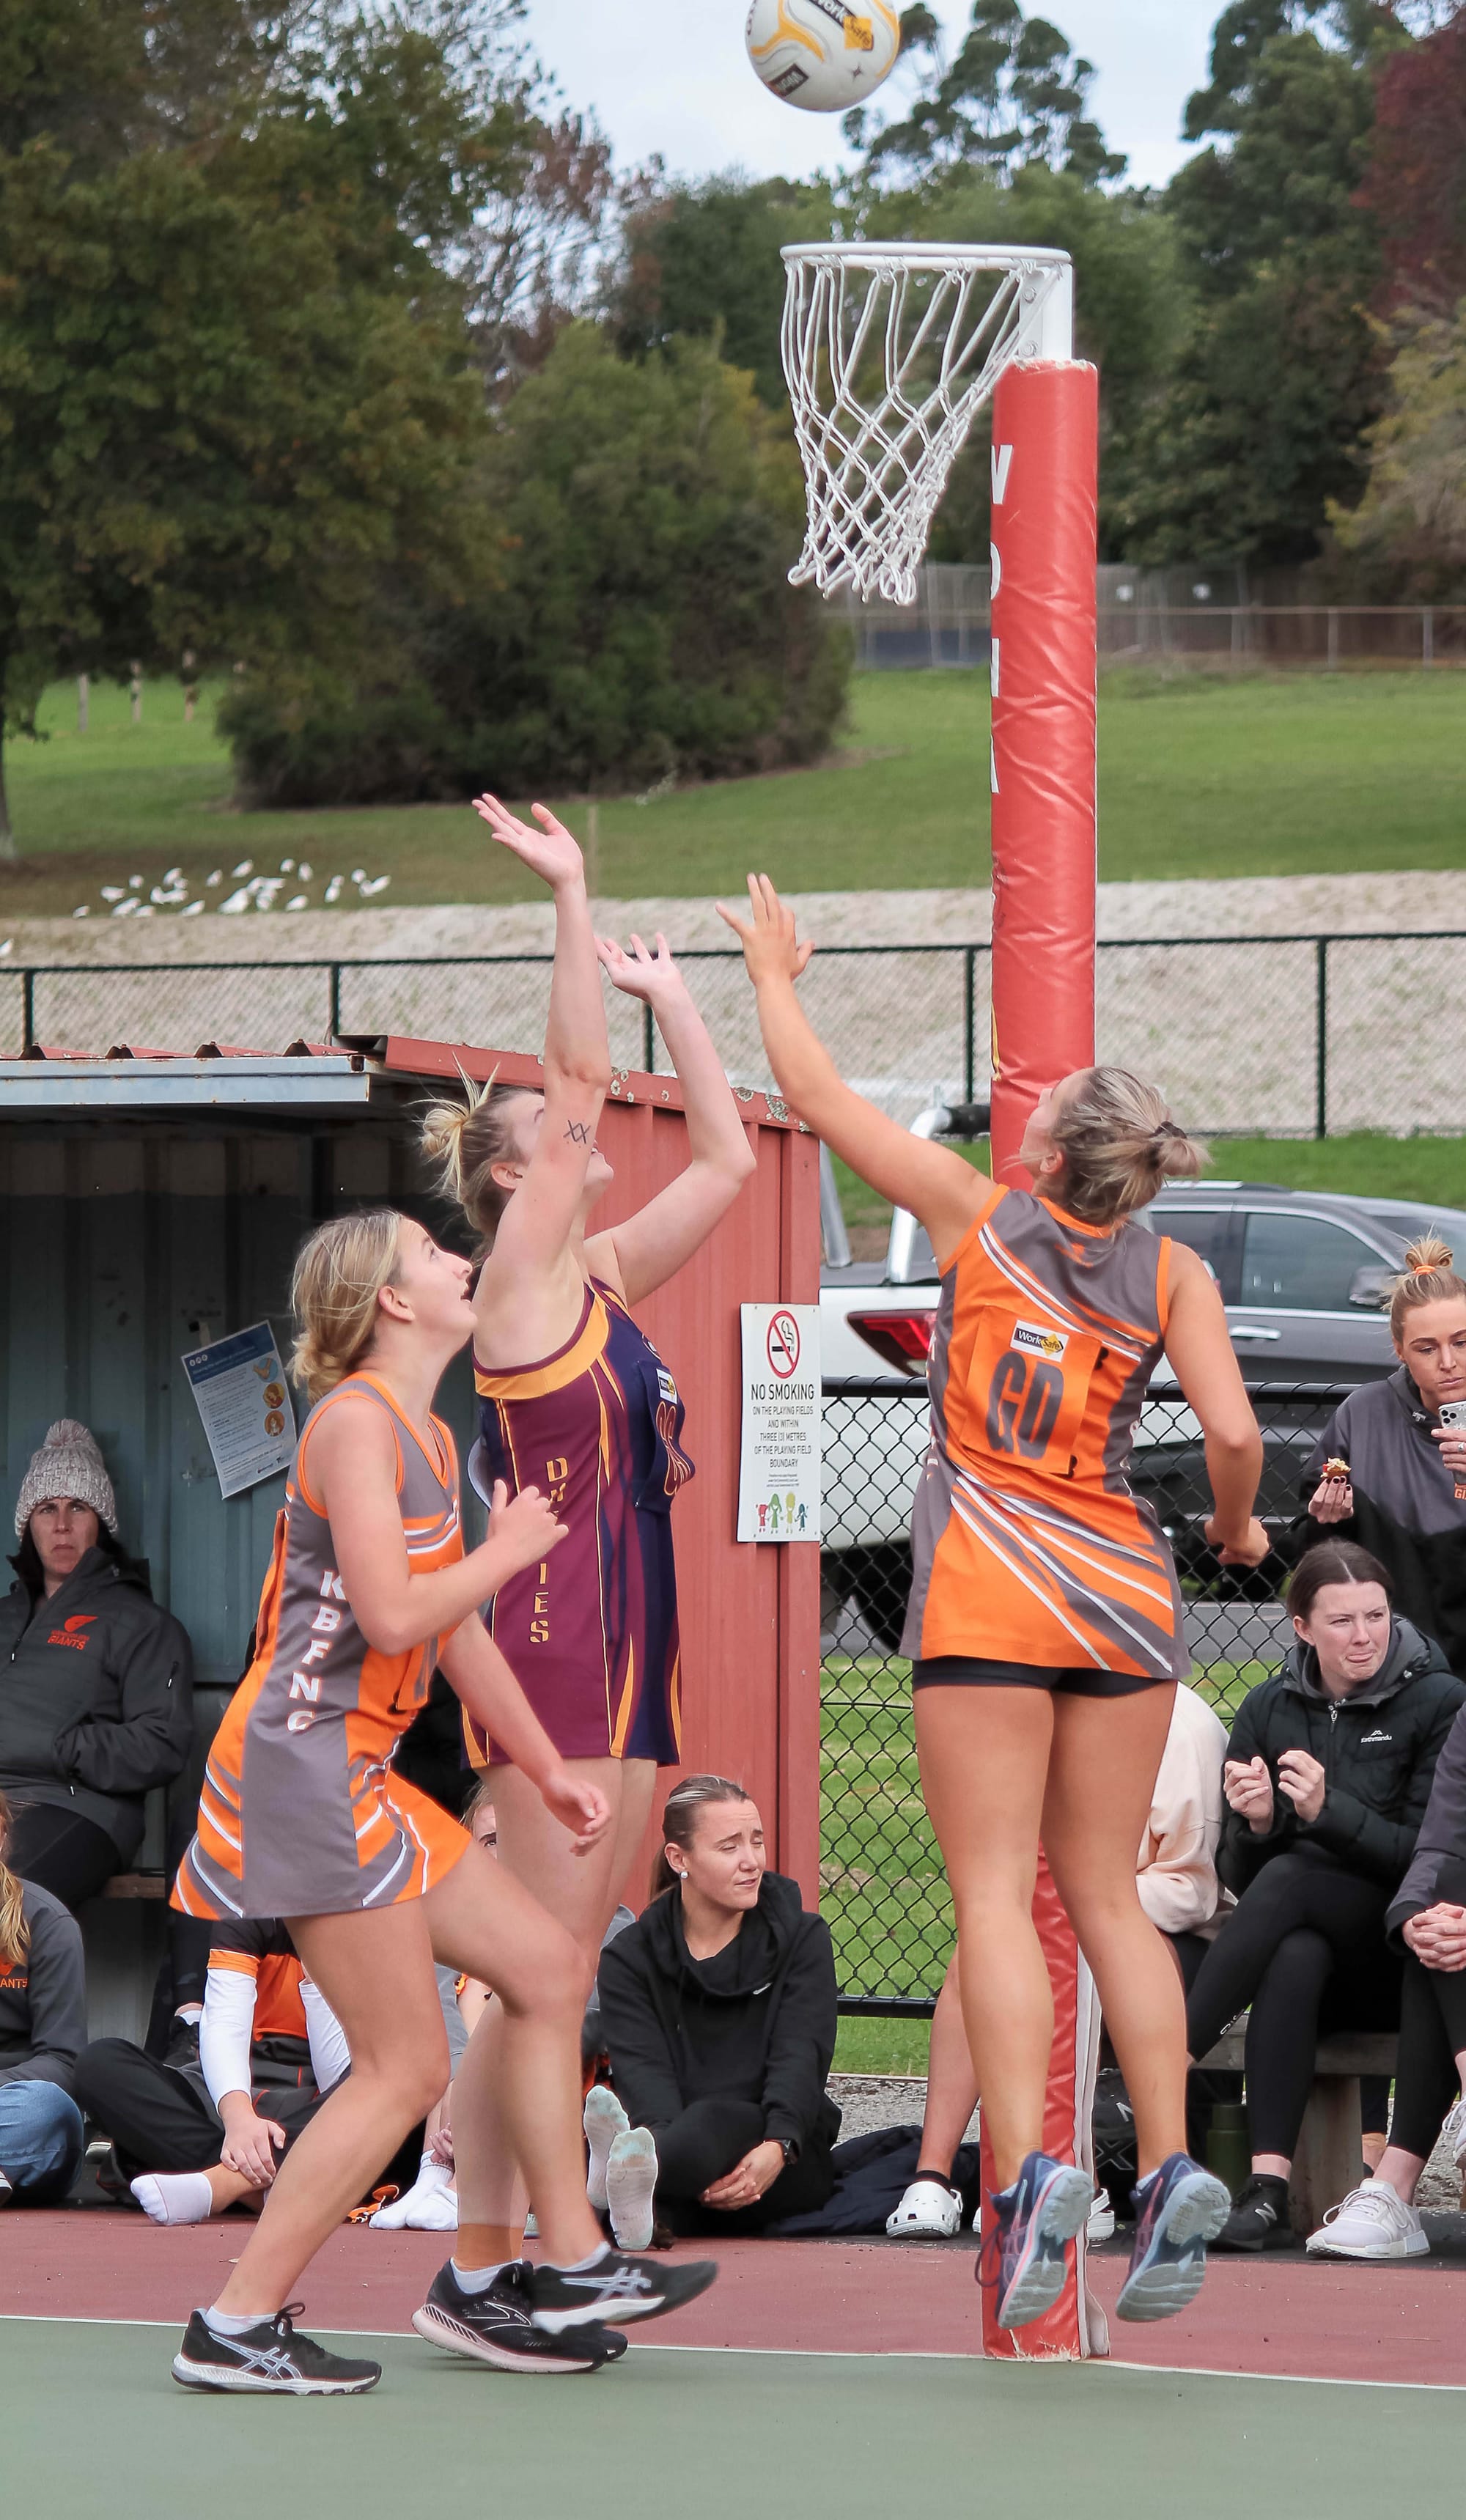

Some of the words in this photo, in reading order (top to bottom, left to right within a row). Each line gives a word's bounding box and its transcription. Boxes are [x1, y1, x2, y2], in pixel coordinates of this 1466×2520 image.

[751, 1384, 765, 1400] NO
[768, 1384, 814, 1400] SMOKING
[985, 1350, 1064, 1460] GD
[752, 1406, 760, 1415] ON
[762, 1406, 772, 1415] THE
[773, 1406, 795, 1415] PLAYING
[796, 1406, 814, 1415] FIELDS
[767, 1419, 778, 1428] AND
[780, 1419, 799, 1428] WITHIN
[760, 1432, 777, 1441] THREE
[786, 1432, 806, 1441] METRES
[754, 1445, 762, 1454] OF
[762, 1445, 773, 1454] THE
[774, 1445, 795, 1454] PLAYING
[797, 1445, 811, 1454] FIELD
[770, 1459, 798, 1467] BOUNDARY
